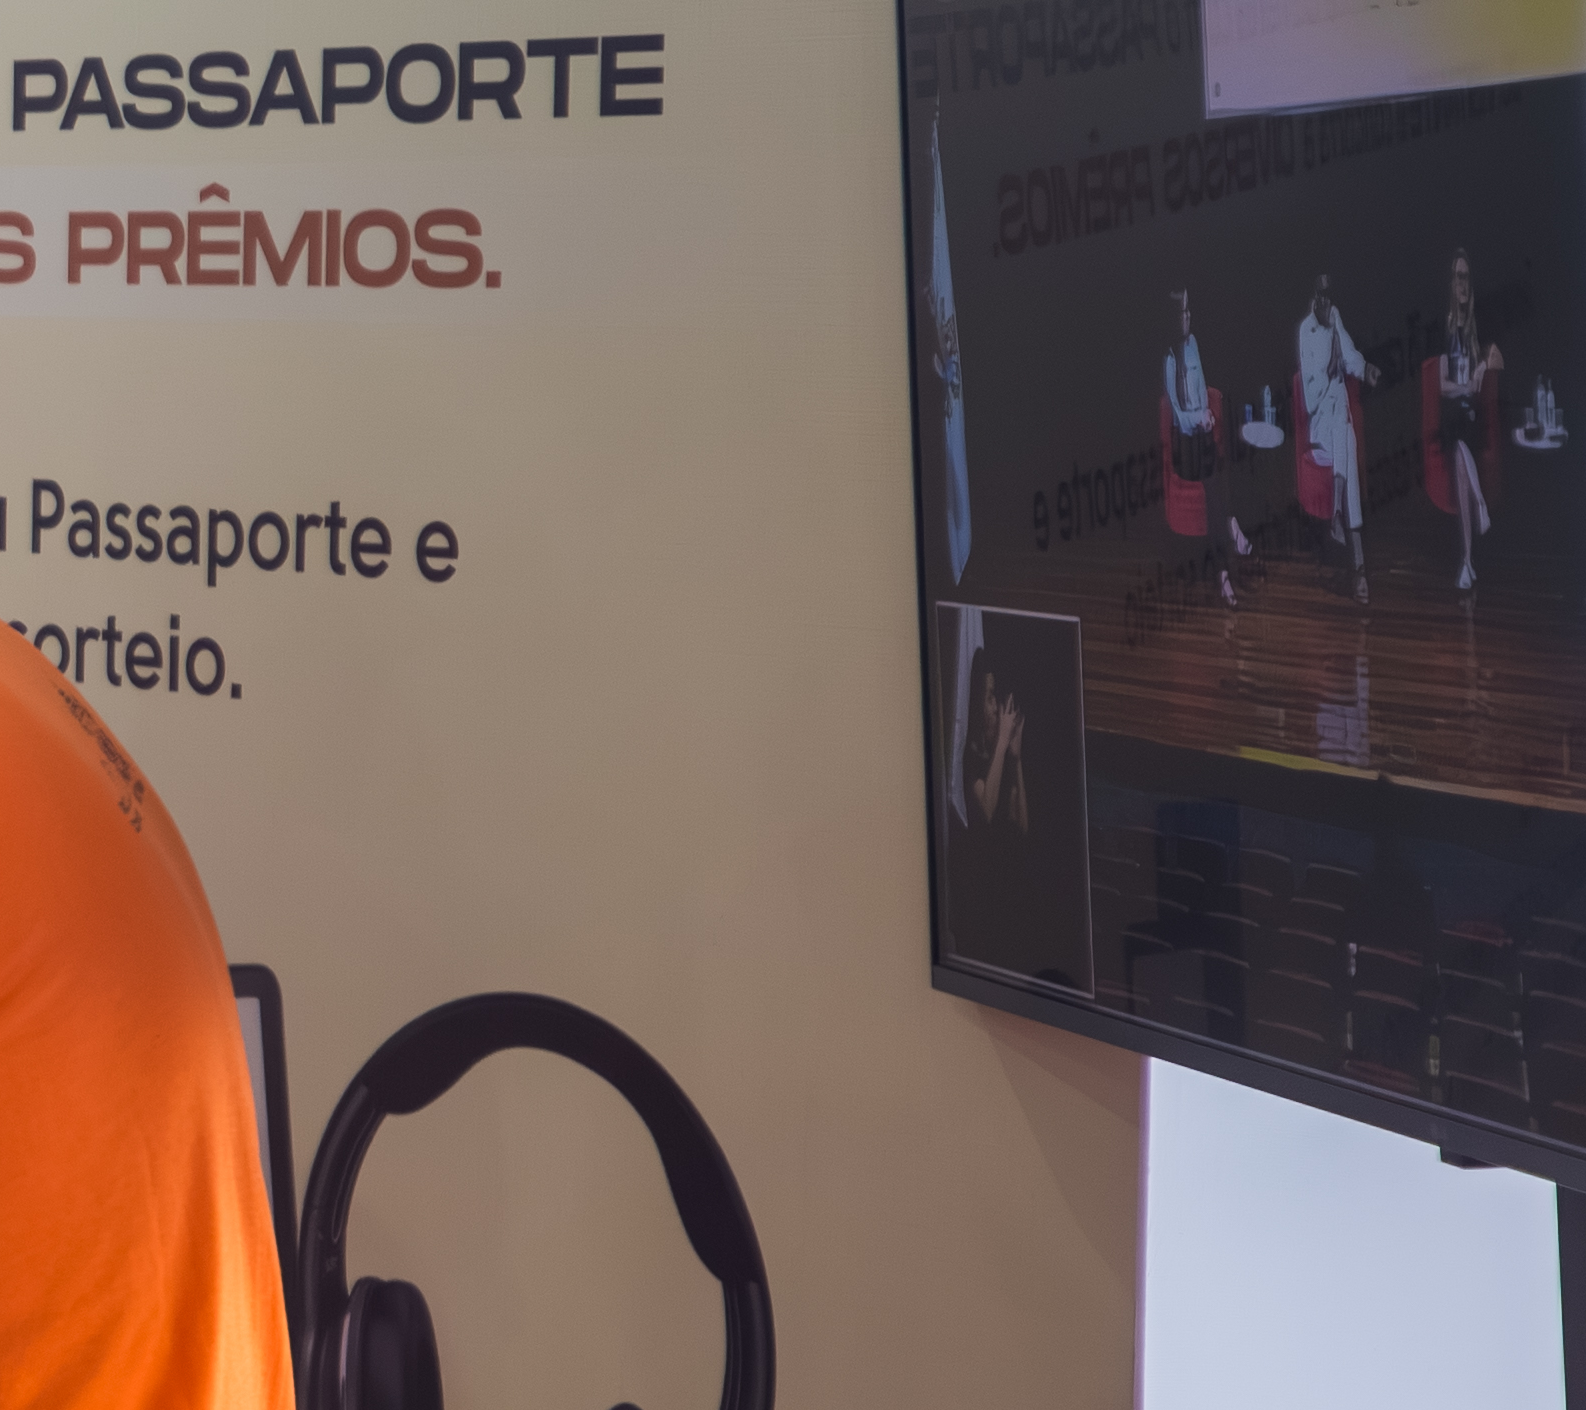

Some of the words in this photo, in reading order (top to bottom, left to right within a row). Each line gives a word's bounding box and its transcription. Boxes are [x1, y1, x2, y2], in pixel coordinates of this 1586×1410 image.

[12, 33, 665, 133] PASSAPORTE
[67, 181, 503, 290] PRÊMIOS.
[31, 478, 392, 588] Passaporte
[415, 519, 459, 583] e
[6, 614, 242, 700] orteio.
